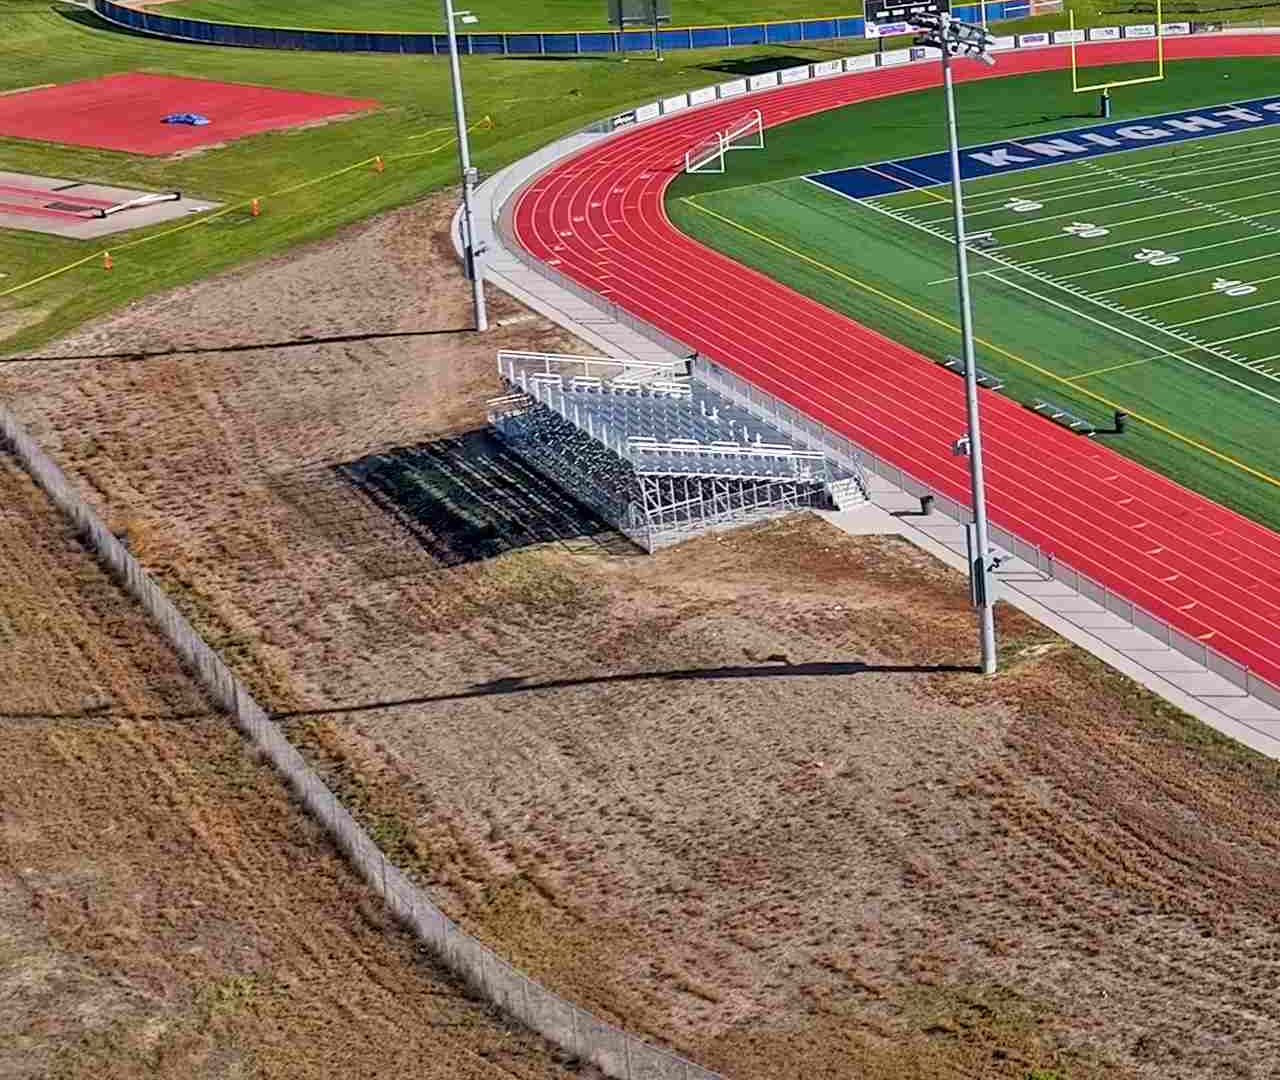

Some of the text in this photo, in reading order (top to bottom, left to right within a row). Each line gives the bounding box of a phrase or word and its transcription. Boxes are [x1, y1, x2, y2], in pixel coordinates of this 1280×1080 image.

[1062, 223, 1110, 238] 20
[1134, 249, 1180, 265] 30
[1212, 279, 1257, 296] 40
